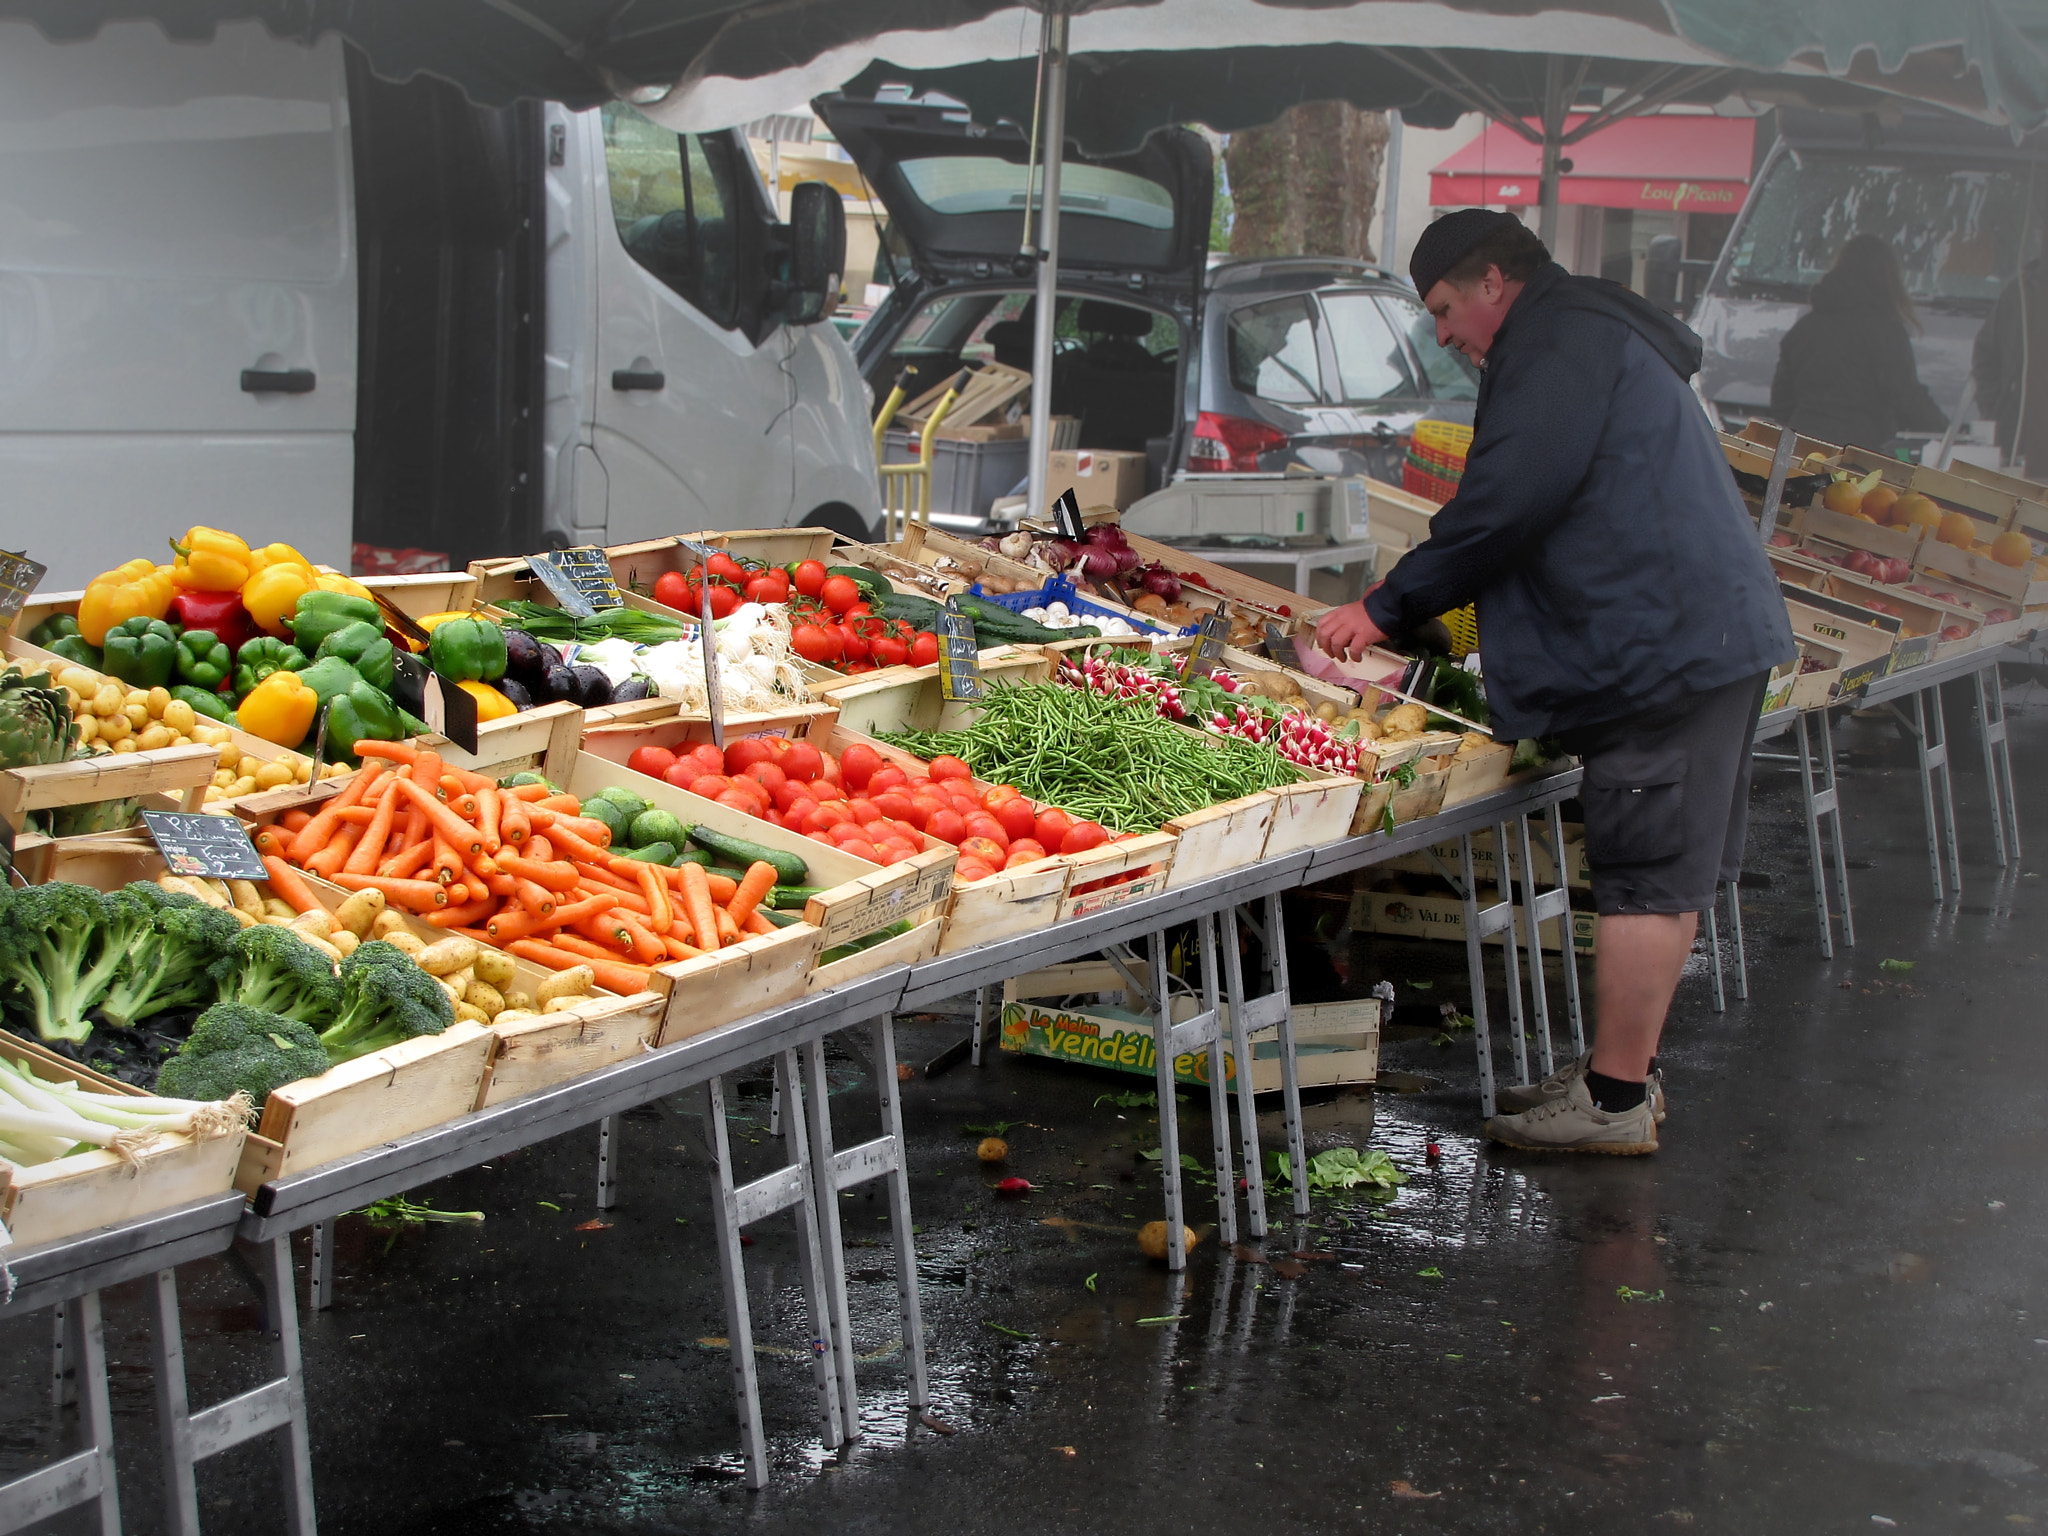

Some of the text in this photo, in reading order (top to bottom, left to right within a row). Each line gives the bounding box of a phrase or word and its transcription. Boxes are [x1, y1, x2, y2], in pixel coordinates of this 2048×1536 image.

[1640, 182, 1672, 199] Lou
[1418, 908, 1460, 924] VAL DE
[1031, 1010, 1099, 1036] Le Melon
[1044, 1021, 1194, 1075] Vendélie
